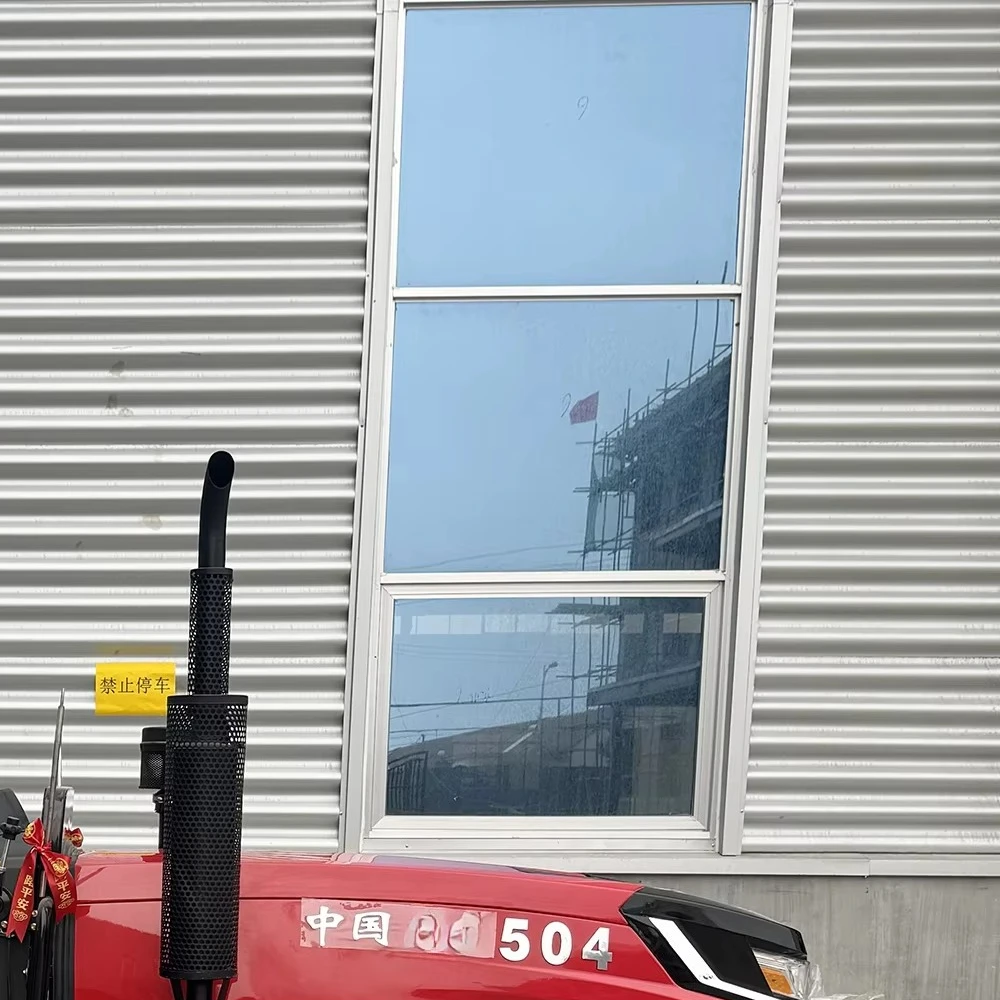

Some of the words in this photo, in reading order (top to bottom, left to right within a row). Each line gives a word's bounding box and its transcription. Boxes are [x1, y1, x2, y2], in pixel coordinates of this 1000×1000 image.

[100, 677, 170, 694] 禁止停车
[305, 906, 390, 947] 中国
[499, 917, 613, 970] 504
